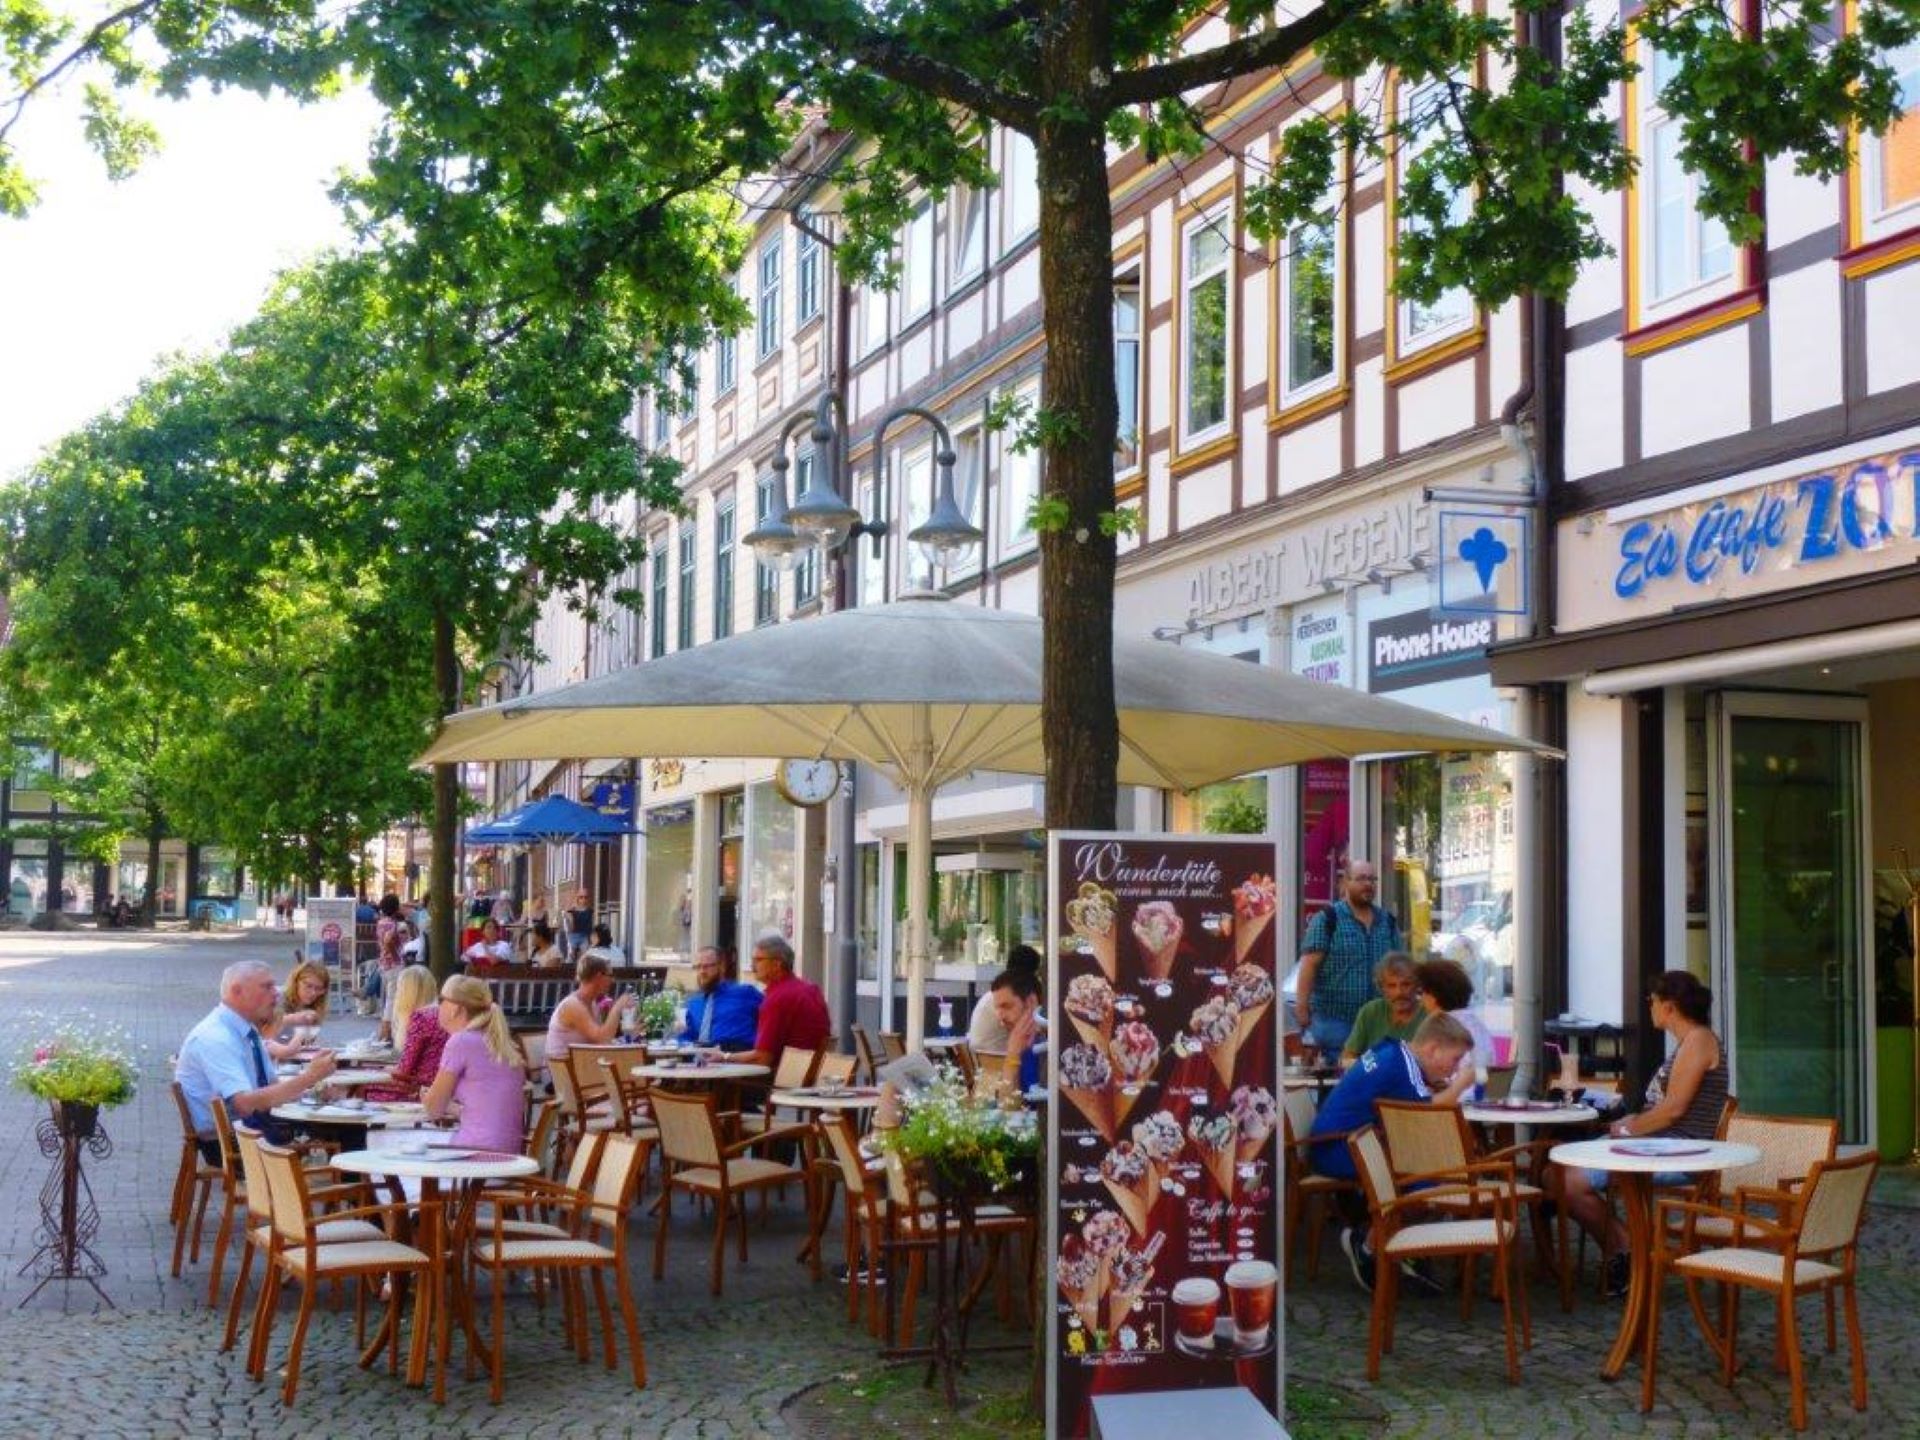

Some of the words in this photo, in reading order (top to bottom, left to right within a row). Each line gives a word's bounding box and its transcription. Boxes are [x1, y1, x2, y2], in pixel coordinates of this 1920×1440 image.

[1188, 543, 1286, 615] ALBERT
[1376, 633, 1430, 667] Phone
[1431, 619, 1491, 654] House
[1075, 842, 1222, 884] Wundertüte
